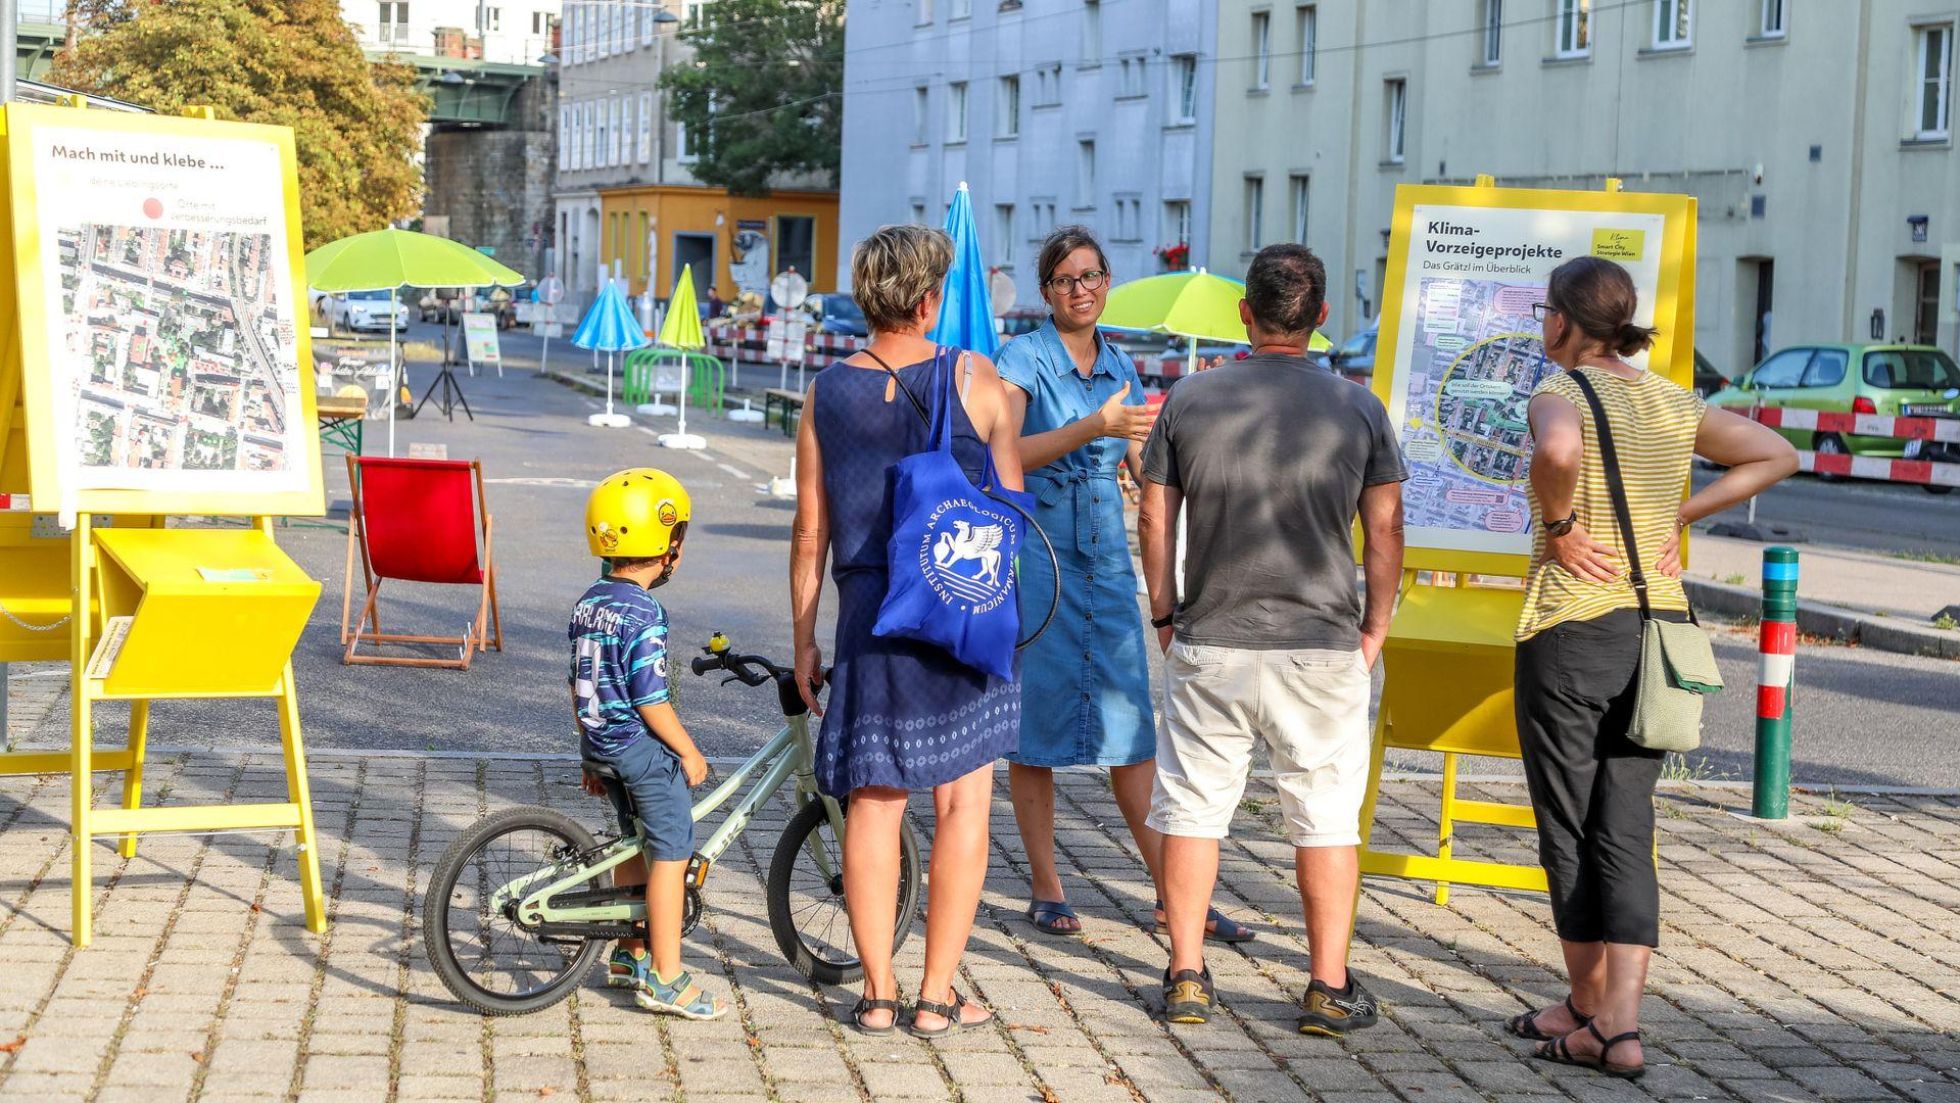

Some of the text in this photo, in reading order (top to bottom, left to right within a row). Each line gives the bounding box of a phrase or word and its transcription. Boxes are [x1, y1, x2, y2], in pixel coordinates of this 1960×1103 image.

[52, 145, 96, 160] Mach
[100, 149, 126, 163] mit
[130, 152, 159, 165] und
[163, 153, 206, 168] klebe
[1428, 221, 1480, 236] Klima-
[1426, 240, 1563, 260] Vorzeigeprojekte
[1423, 260, 1531, 274] Das Grätzl im Überblick
[920, 533, 954, 605] INSTITUTUM
